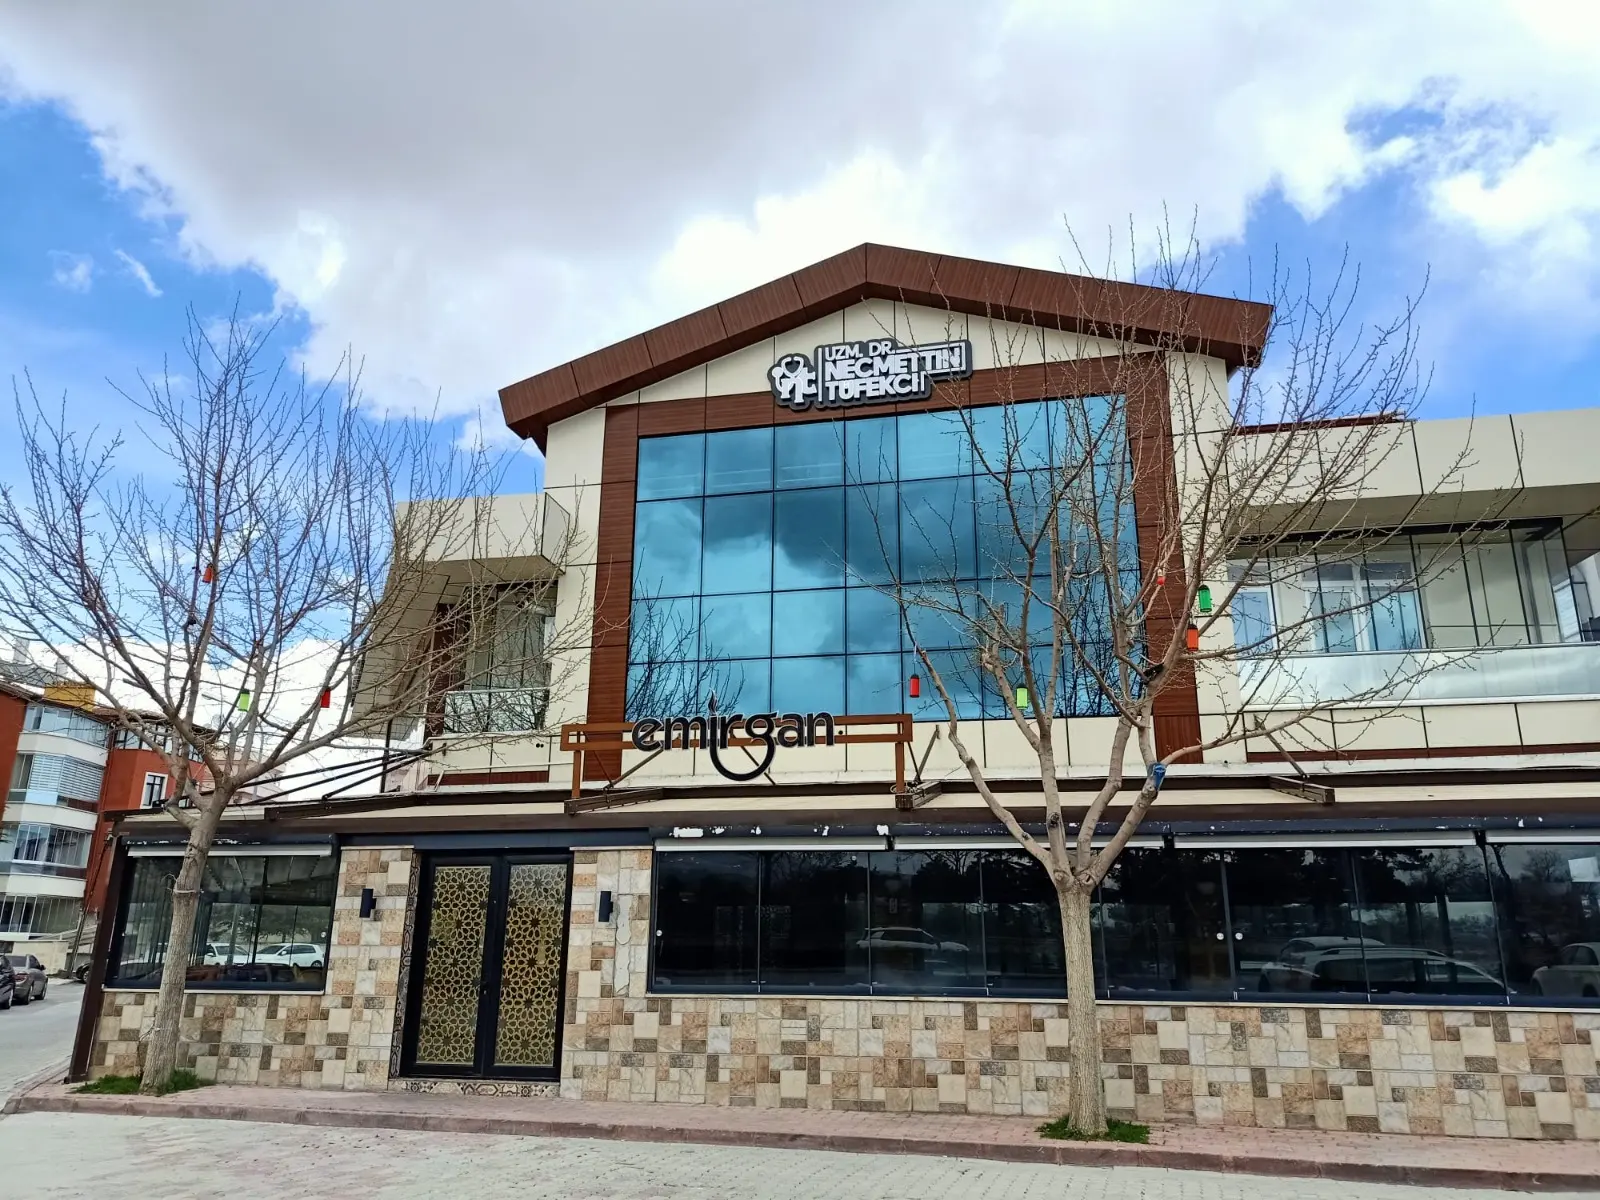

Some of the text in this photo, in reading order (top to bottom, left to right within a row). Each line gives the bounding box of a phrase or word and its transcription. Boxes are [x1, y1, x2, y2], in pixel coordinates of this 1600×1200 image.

[825, 341, 895, 361] UZM. DR.
[632, 710, 835, 782] emirgan
